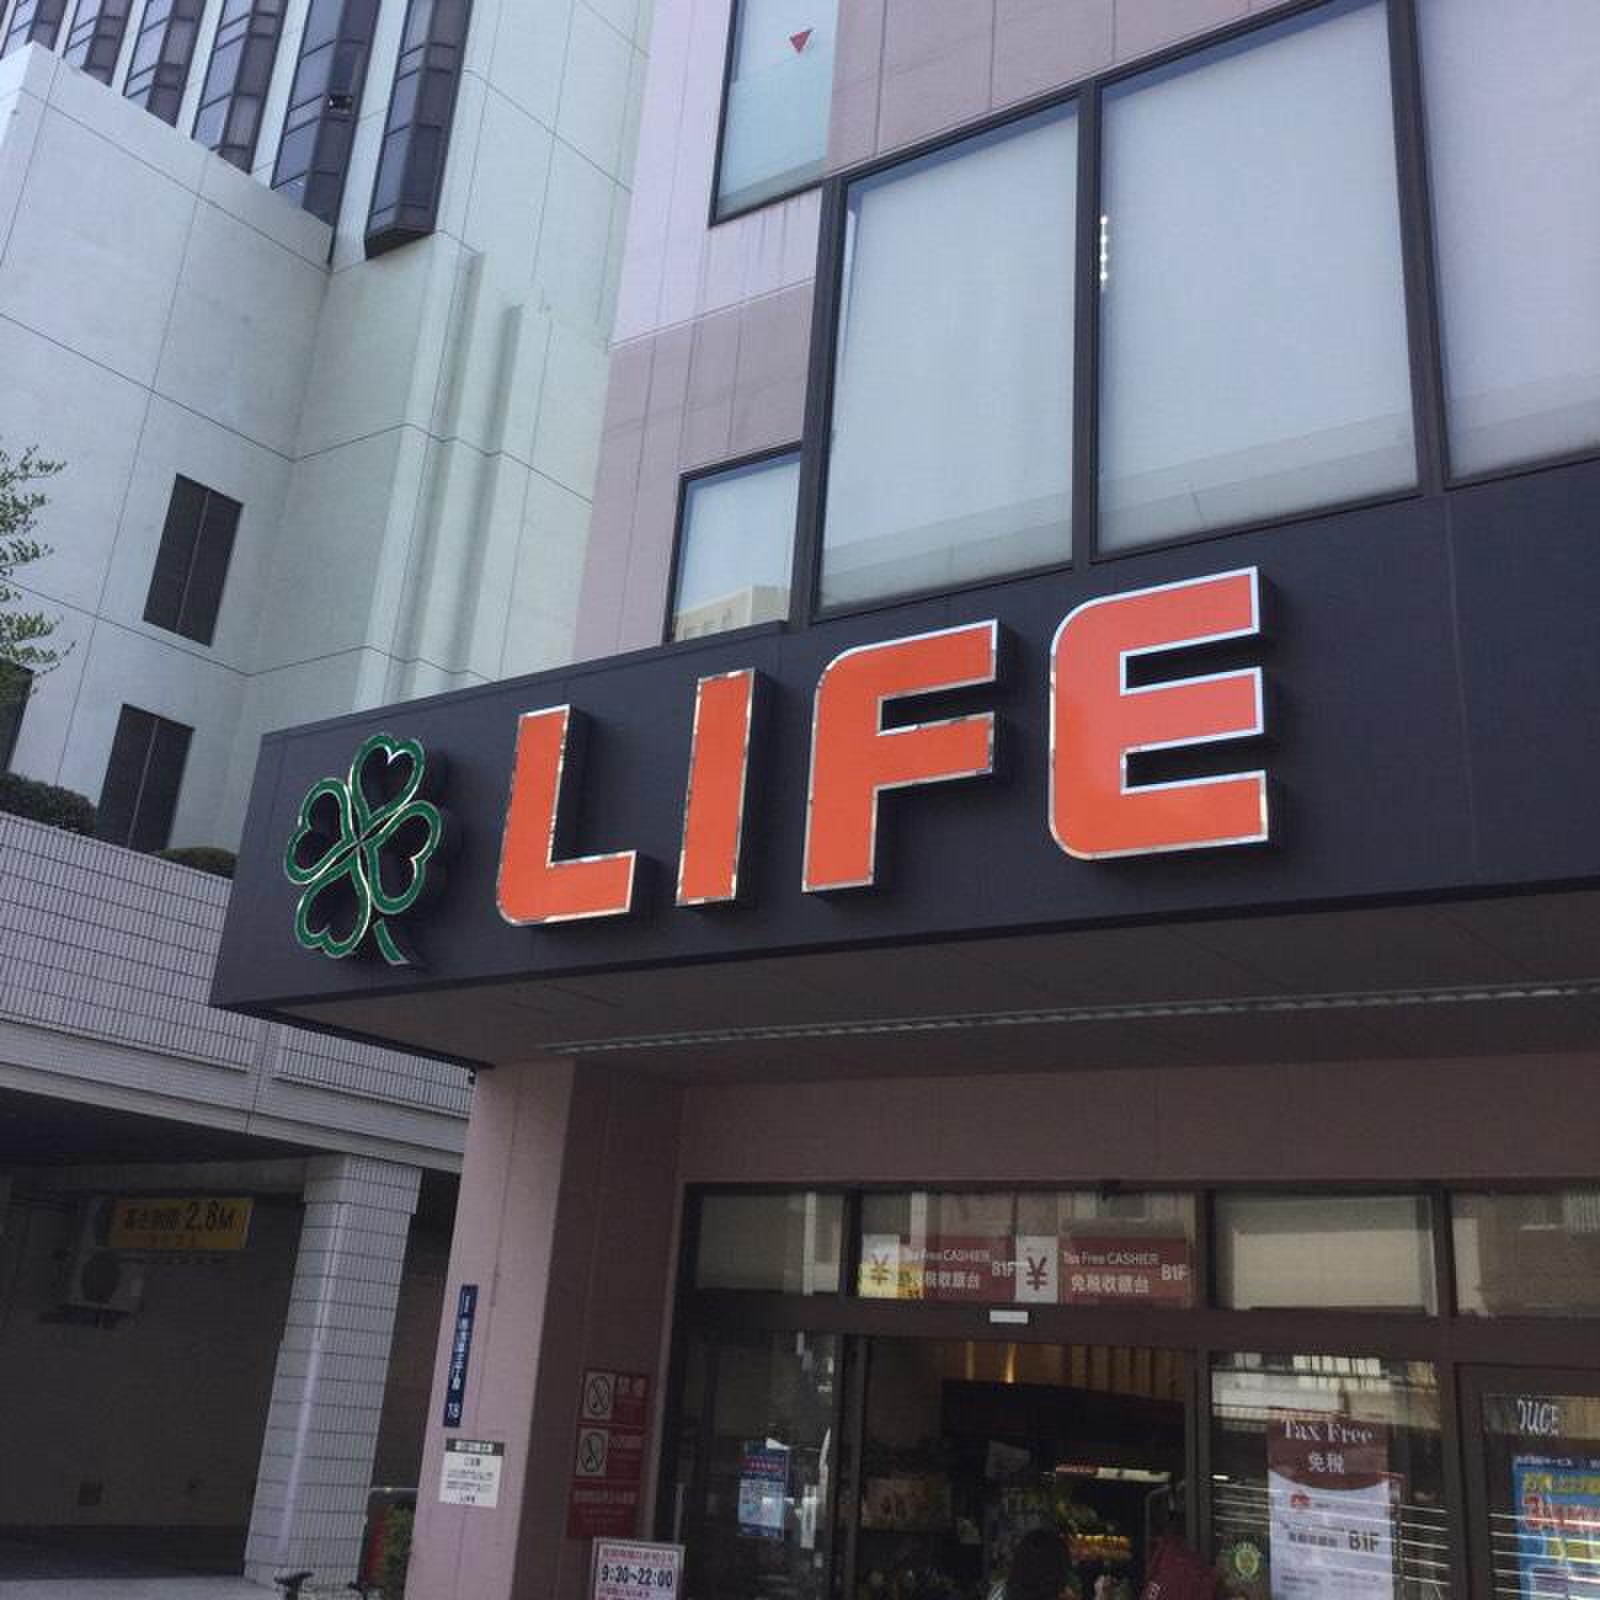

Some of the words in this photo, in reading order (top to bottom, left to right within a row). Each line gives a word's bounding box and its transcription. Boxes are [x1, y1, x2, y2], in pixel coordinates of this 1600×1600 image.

[496, 566, 1269, 926] LIFE
[944, 1249, 991, 1262] CASHIER
[1064, 1252, 1080, 1264] Tax
[1083, 1252, 1105, 1265] Free
[1107, 1253, 1159, 1265] CASHIER
[1280, 1417, 1322, 1441] Tax
[1327, 1422, 1374, 1444] Free
